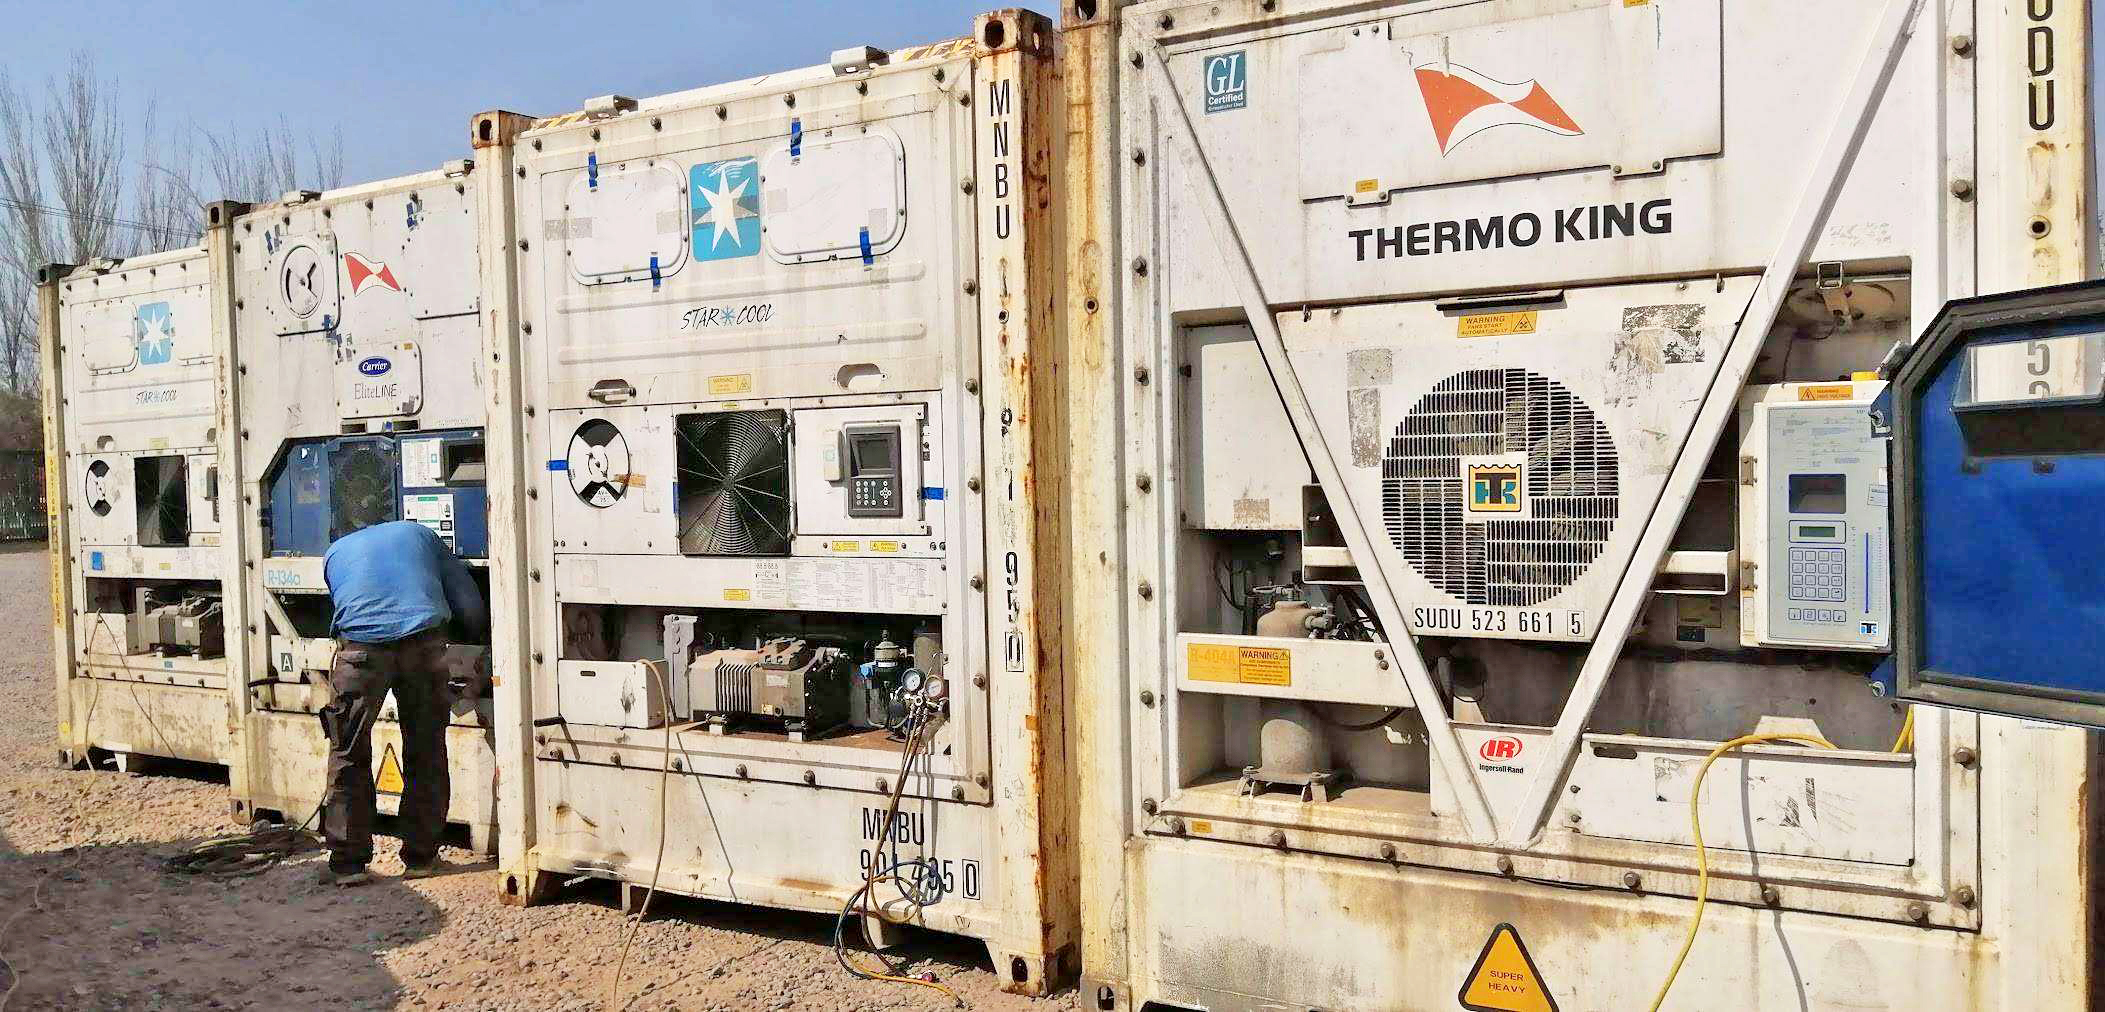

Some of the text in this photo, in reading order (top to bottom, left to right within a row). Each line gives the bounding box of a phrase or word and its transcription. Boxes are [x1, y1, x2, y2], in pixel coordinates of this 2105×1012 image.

[1207, 54, 1244, 95] GL
[1208, 92, 1243, 105] Certified
[989, 78, 1010, 239] MNBU
[1348, 198, 1672, 262] THERMO KING
[680, 303, 776, 330] STAR COOL
[1465, 315, 1505, 324] WARNING
[362, 361, 388, 371] Carrier
[1414, 607, 1581, 634] SUDU 523 661 5
[282, 655, 292, 671] A
[1240, 650, 1278, 660] WARNING
[1486, 739, 1516, 758] IR
[965, 863, 977, 897] 0
[1490, 970, 1524, 982] SUPER
[1488, 982, 1526, 994] HEAVY
